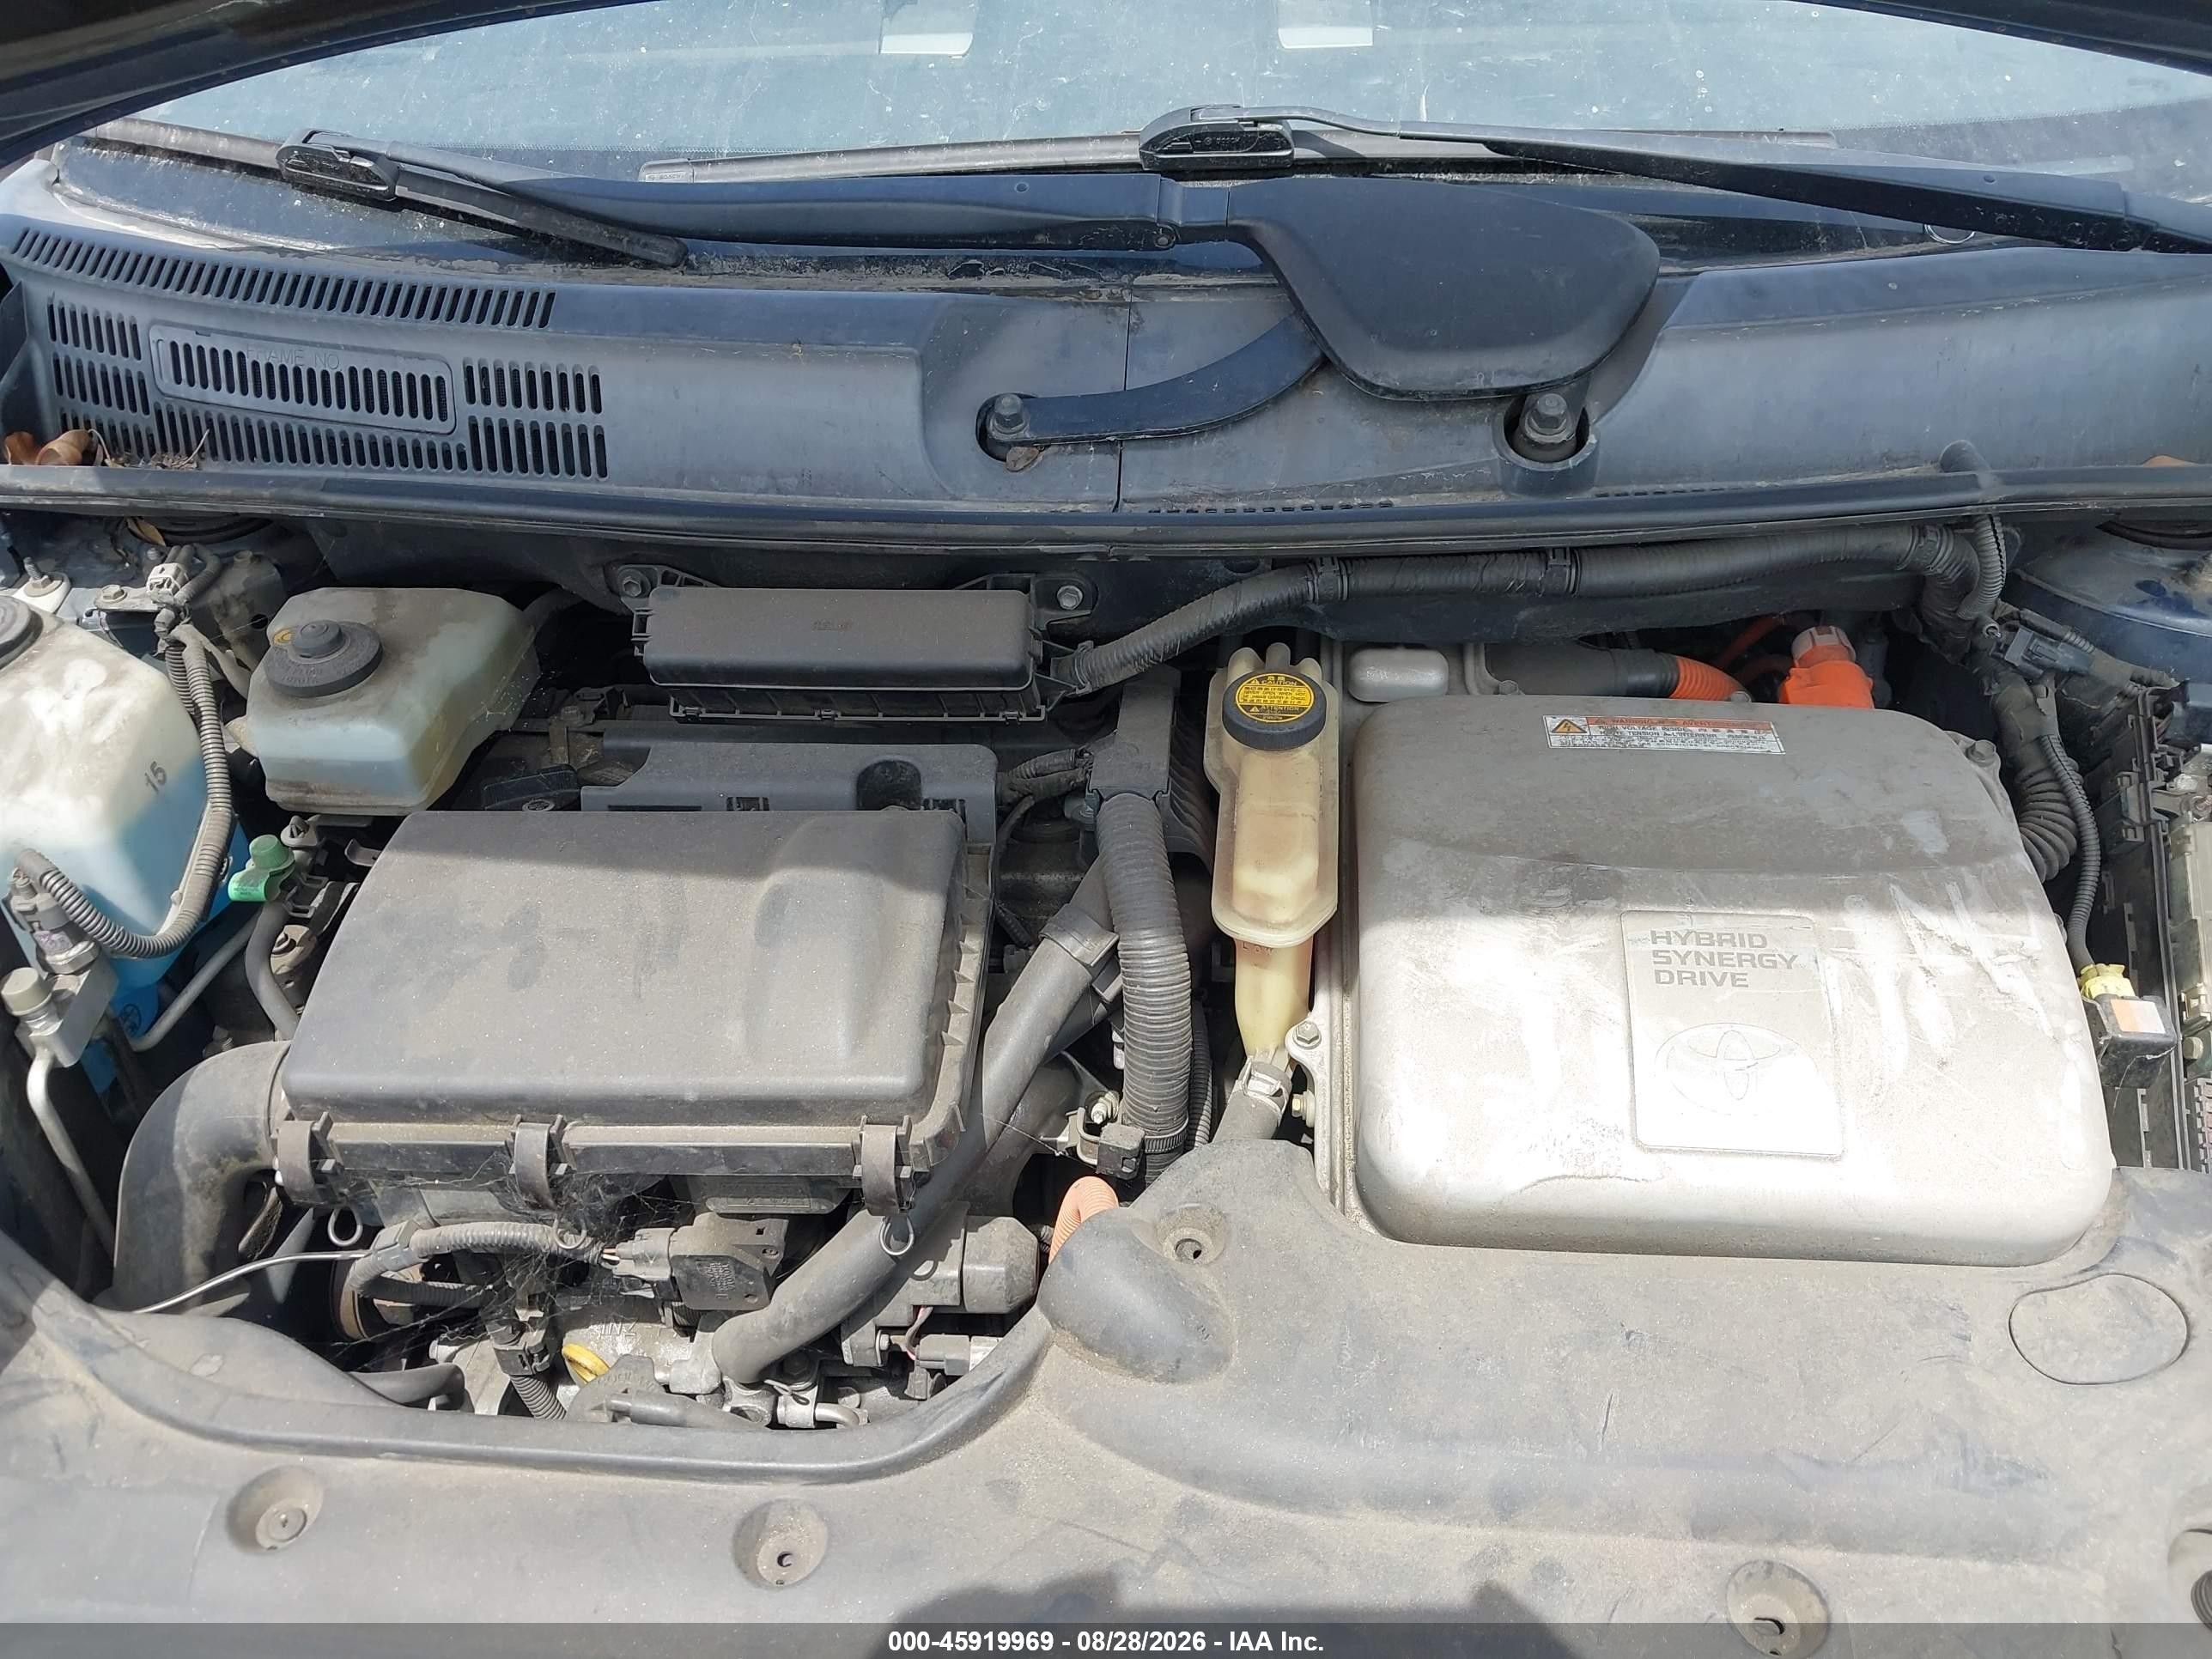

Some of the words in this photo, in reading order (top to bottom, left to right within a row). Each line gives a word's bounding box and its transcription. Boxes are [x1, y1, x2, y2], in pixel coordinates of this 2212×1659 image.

[144, 761, 167, 795] 15
[1650, 930, 1768, 949] HYBRID
[1652, 949, 1799, 970] SYNERGY
[1654, 969, 1749, 988] DRIVE
